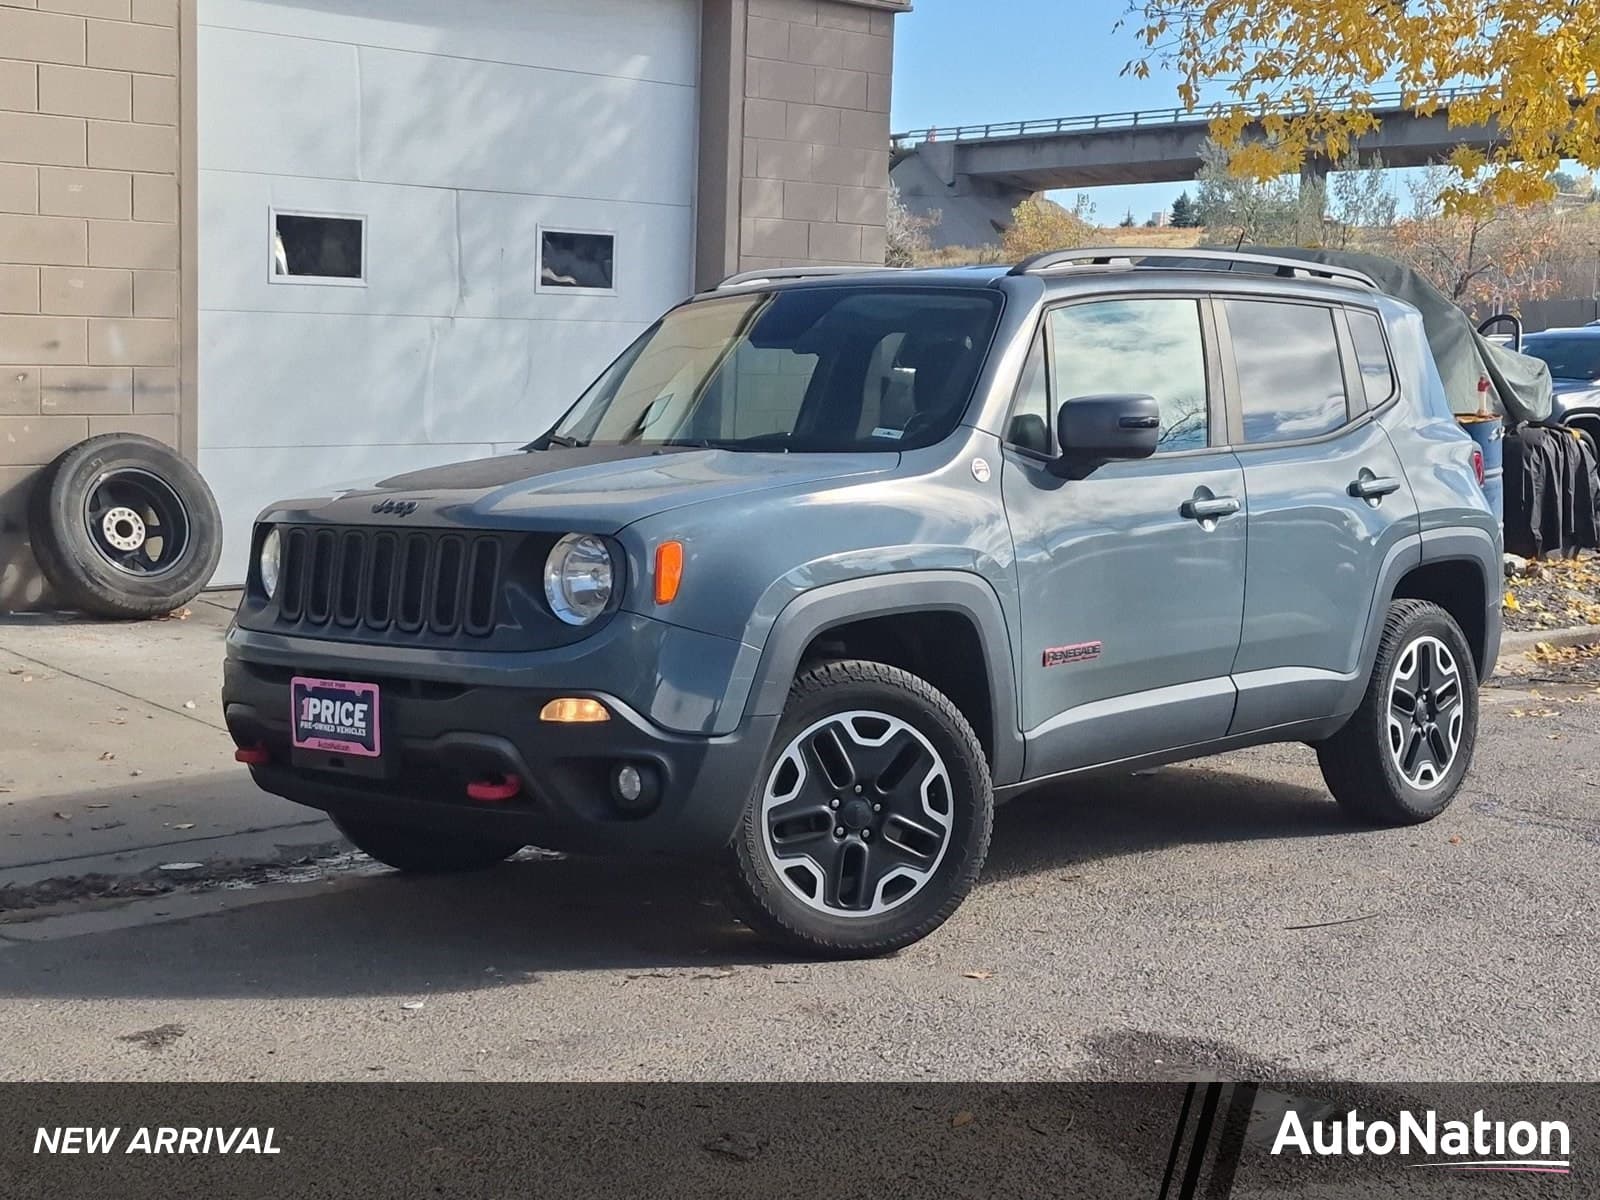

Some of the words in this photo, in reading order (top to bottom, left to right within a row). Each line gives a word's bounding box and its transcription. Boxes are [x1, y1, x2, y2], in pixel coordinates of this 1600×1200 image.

[371, 497, 418, 518] Jeep
[1047, 644, 1101, 662] RENEGADE
[300, 720, 335, 732] PRE-OWNED
[336, 725, 366, 736] VEHICLES
